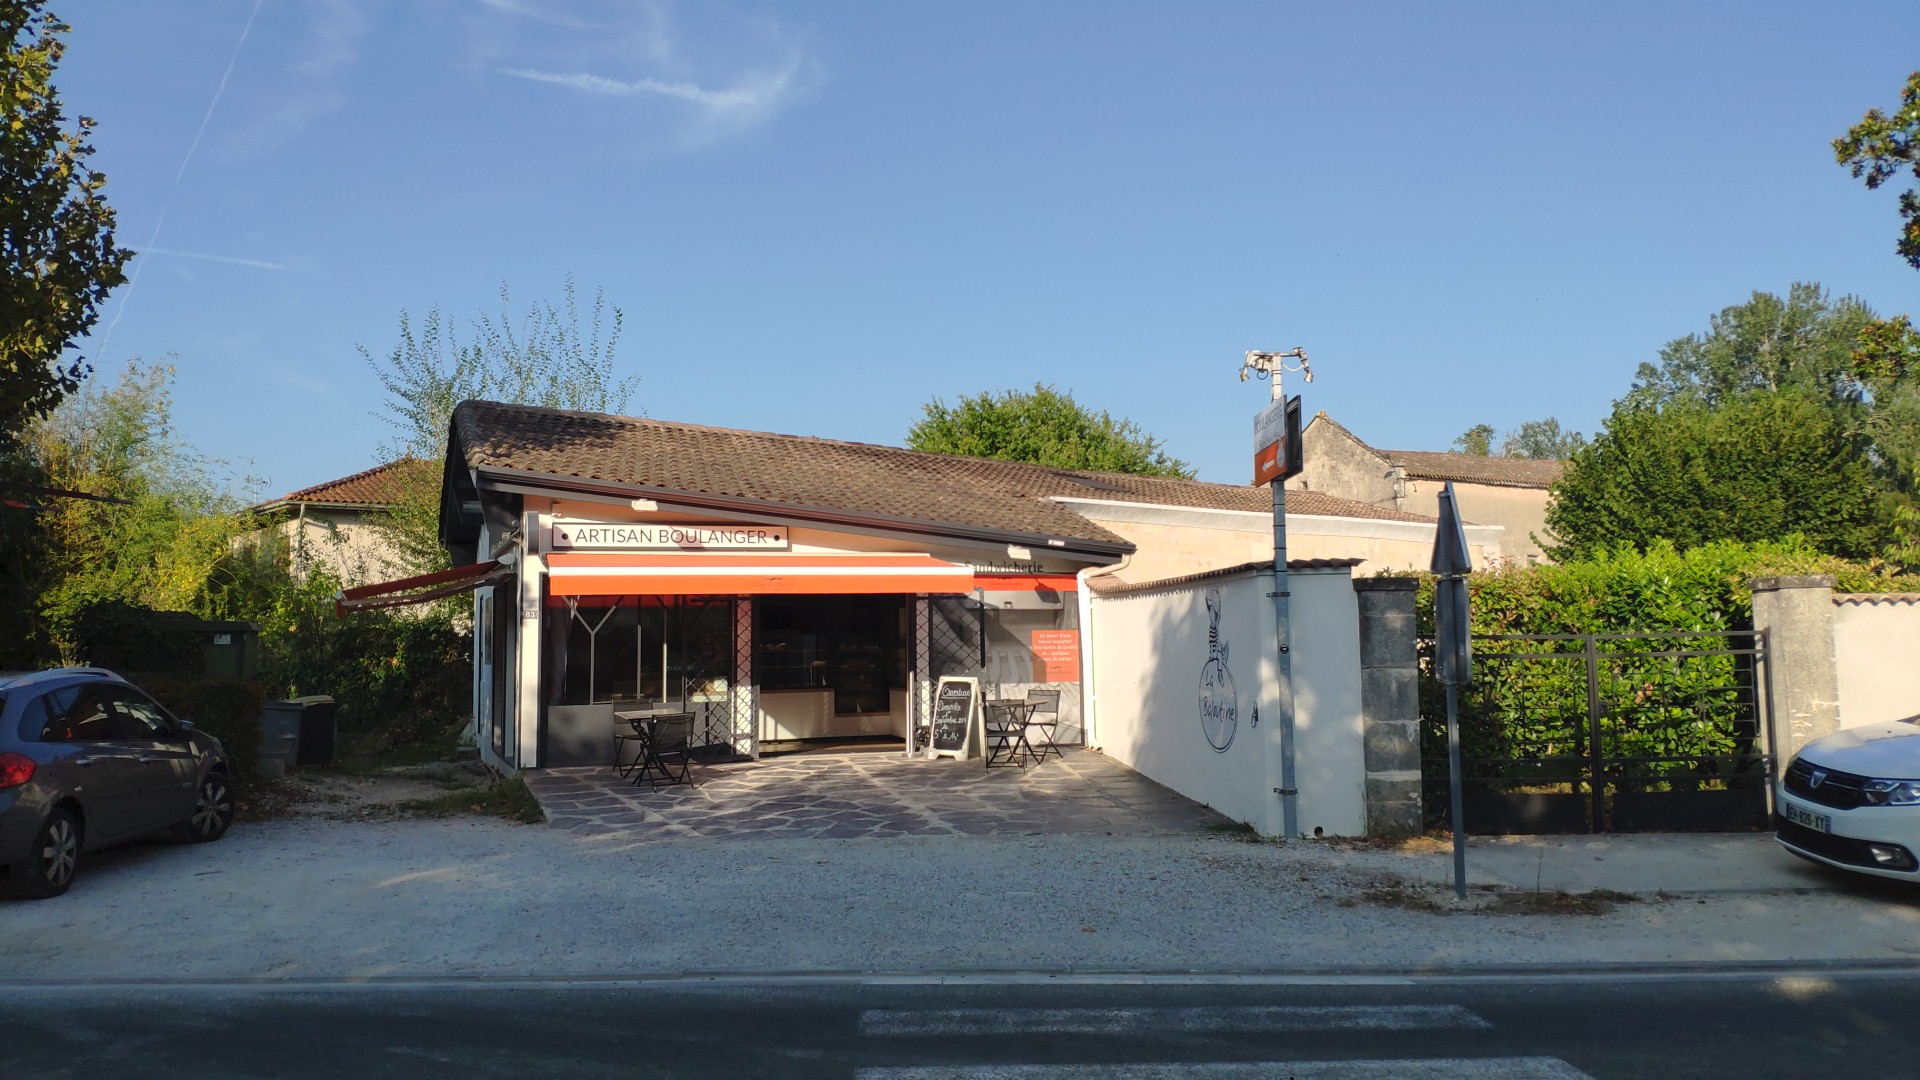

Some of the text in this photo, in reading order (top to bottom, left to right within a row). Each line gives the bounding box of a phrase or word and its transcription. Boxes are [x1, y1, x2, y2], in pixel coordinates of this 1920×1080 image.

[575, 528, 767, 543] ARTISAN BOULANGER
[1205, 669, 1214, 689] La
